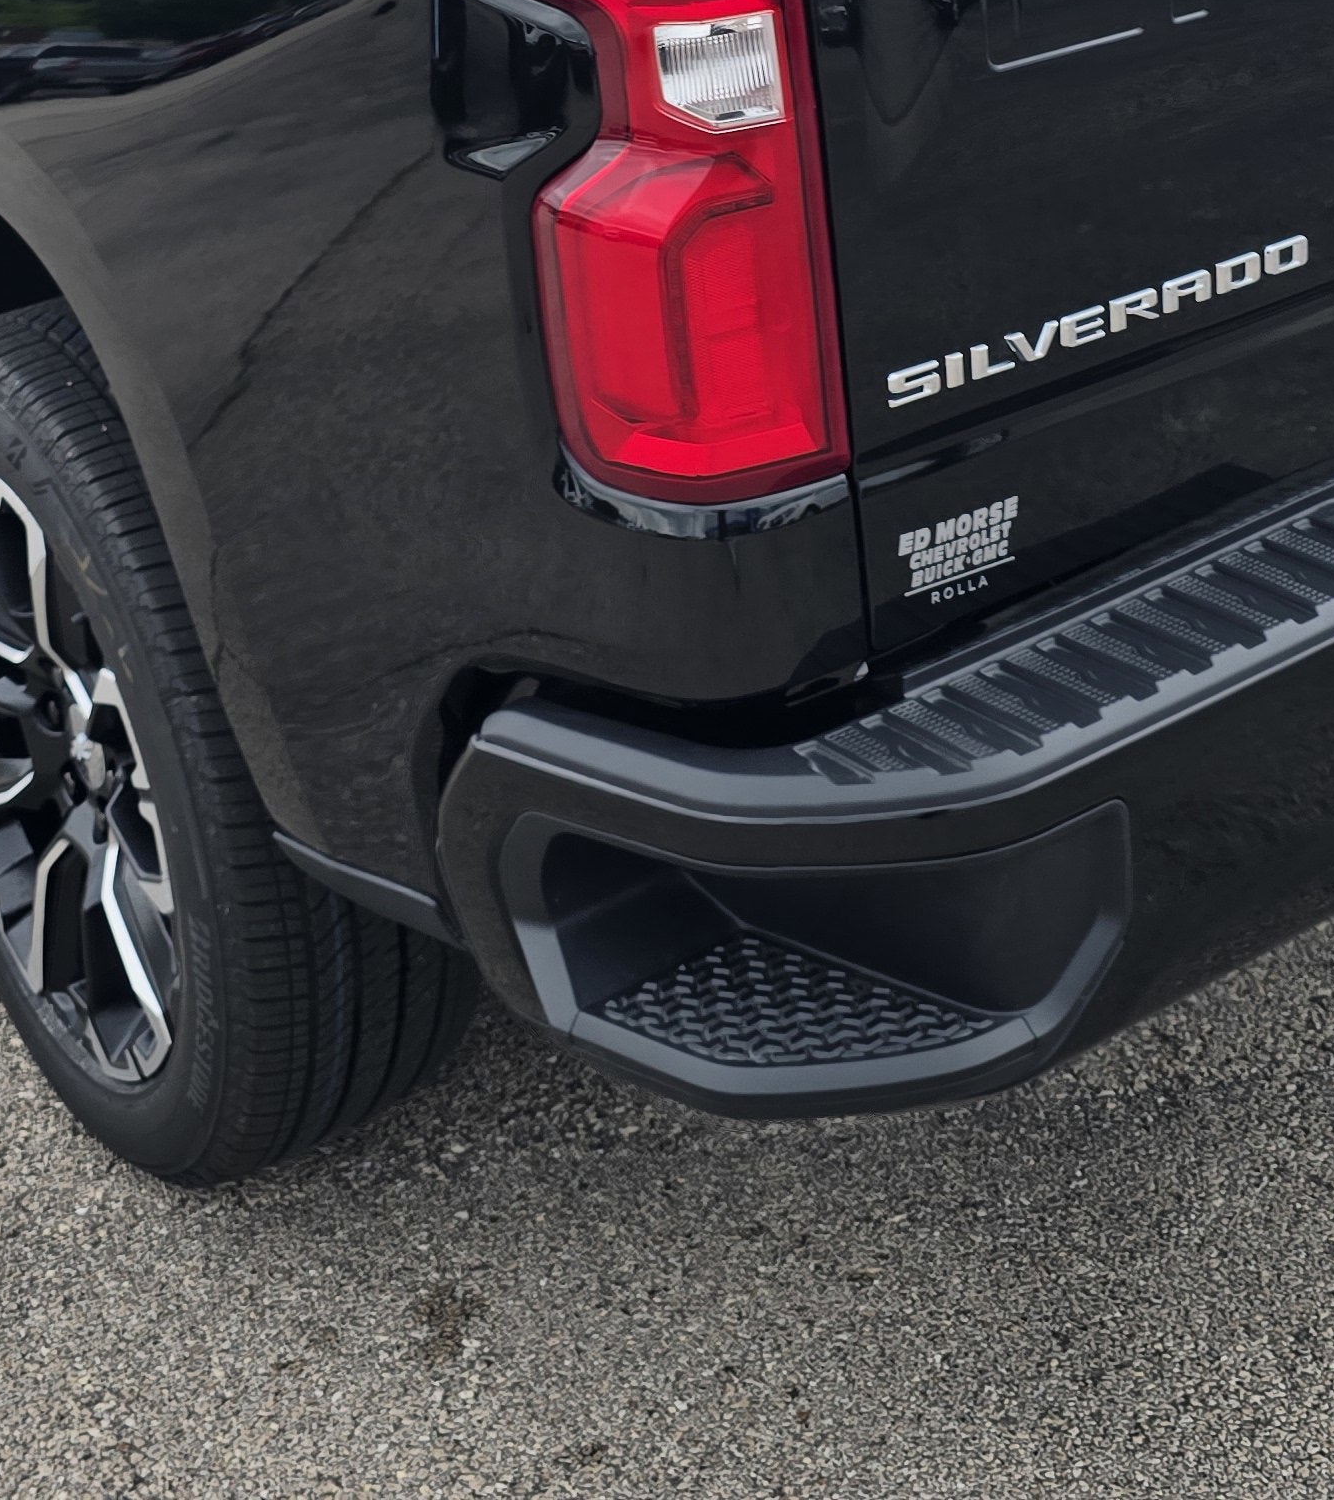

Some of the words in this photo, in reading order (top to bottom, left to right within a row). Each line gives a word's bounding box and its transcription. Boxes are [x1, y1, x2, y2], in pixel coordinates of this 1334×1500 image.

[887, 233, 1310, 408] SILVERADO
[898, 527, 932, 557] ED
[935, 495, 1019, 545] MORSE
[909, 520, 1013, 571] CHEVROLET
[930, 575, 989, 605] ROLLA
